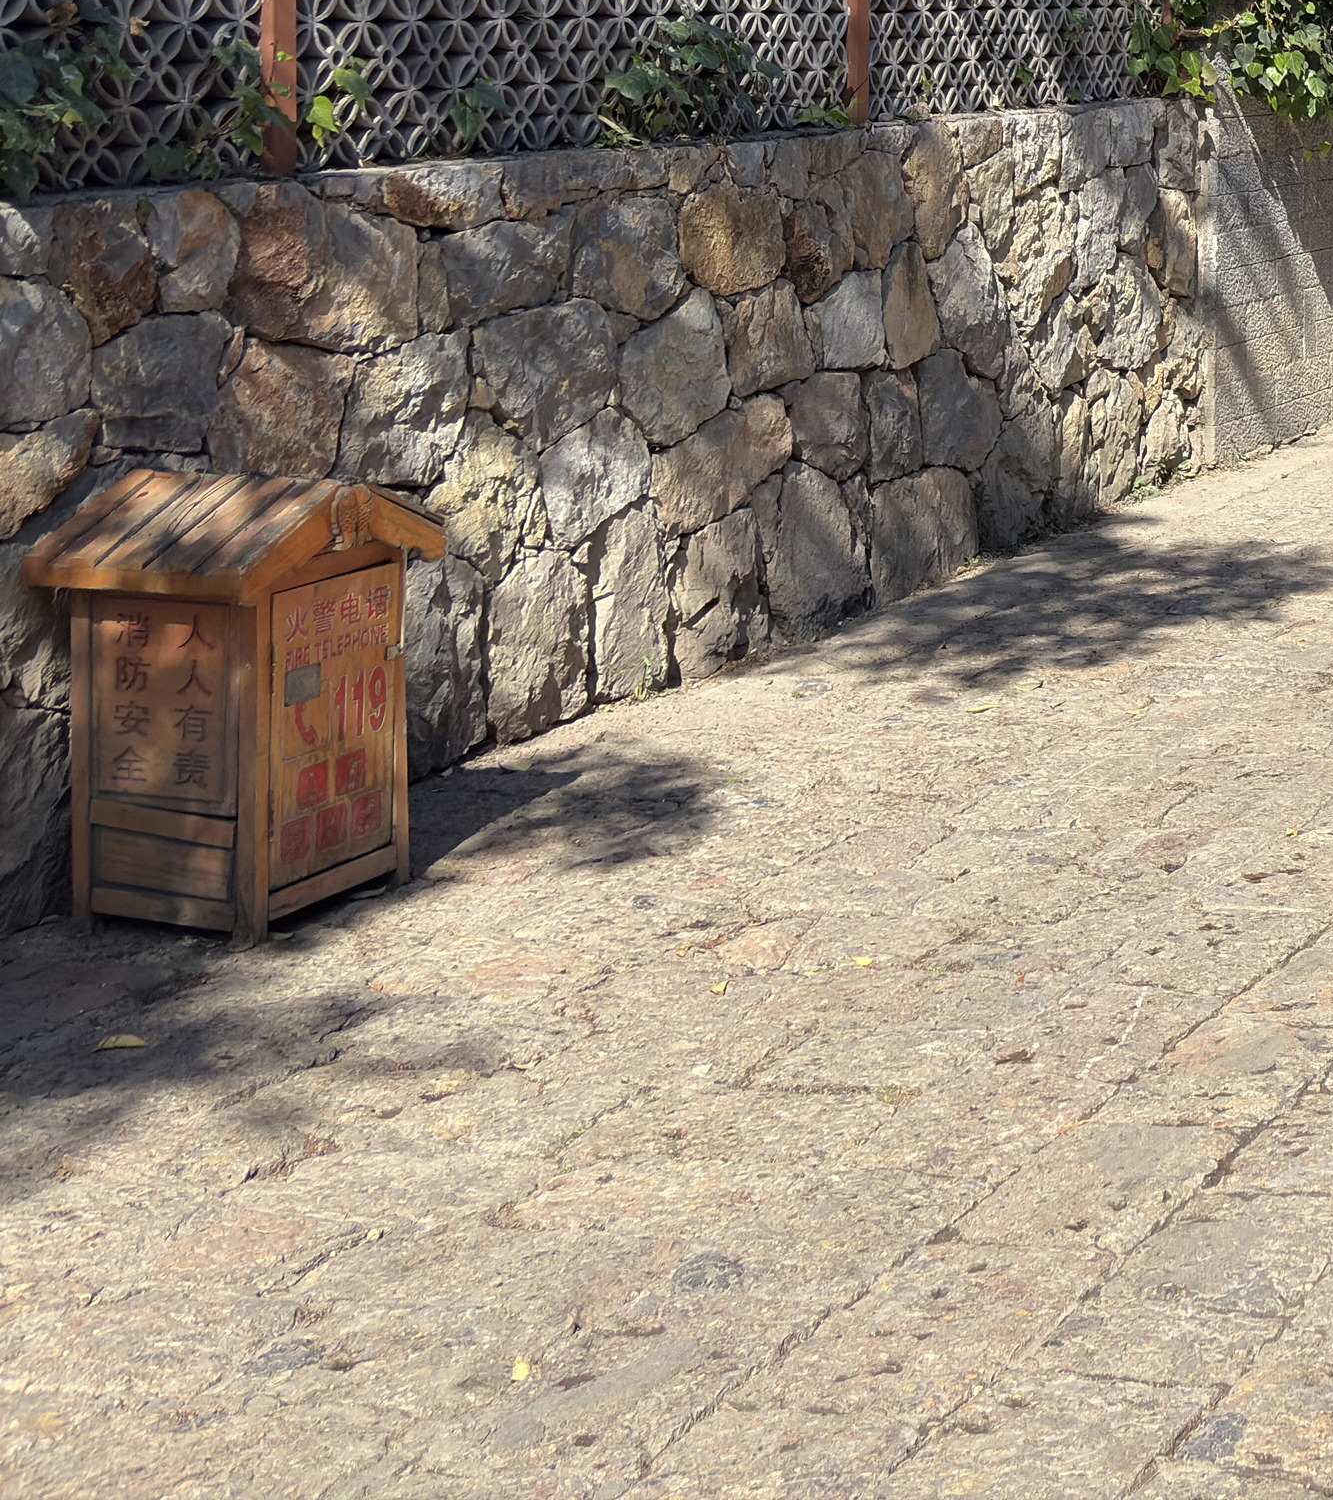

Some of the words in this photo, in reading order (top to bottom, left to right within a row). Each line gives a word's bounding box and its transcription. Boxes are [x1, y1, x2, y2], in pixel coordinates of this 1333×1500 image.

[285, 584, 392, 644] 火警电话
[285, 645, 311, 671] FIRE
[315, 623, 389, 662] TELEPHONE
[112, 611, 152, 782] 消防安全
[172, 614, 215, 789] 人人有责
[334, 665, 387, 742] 119
